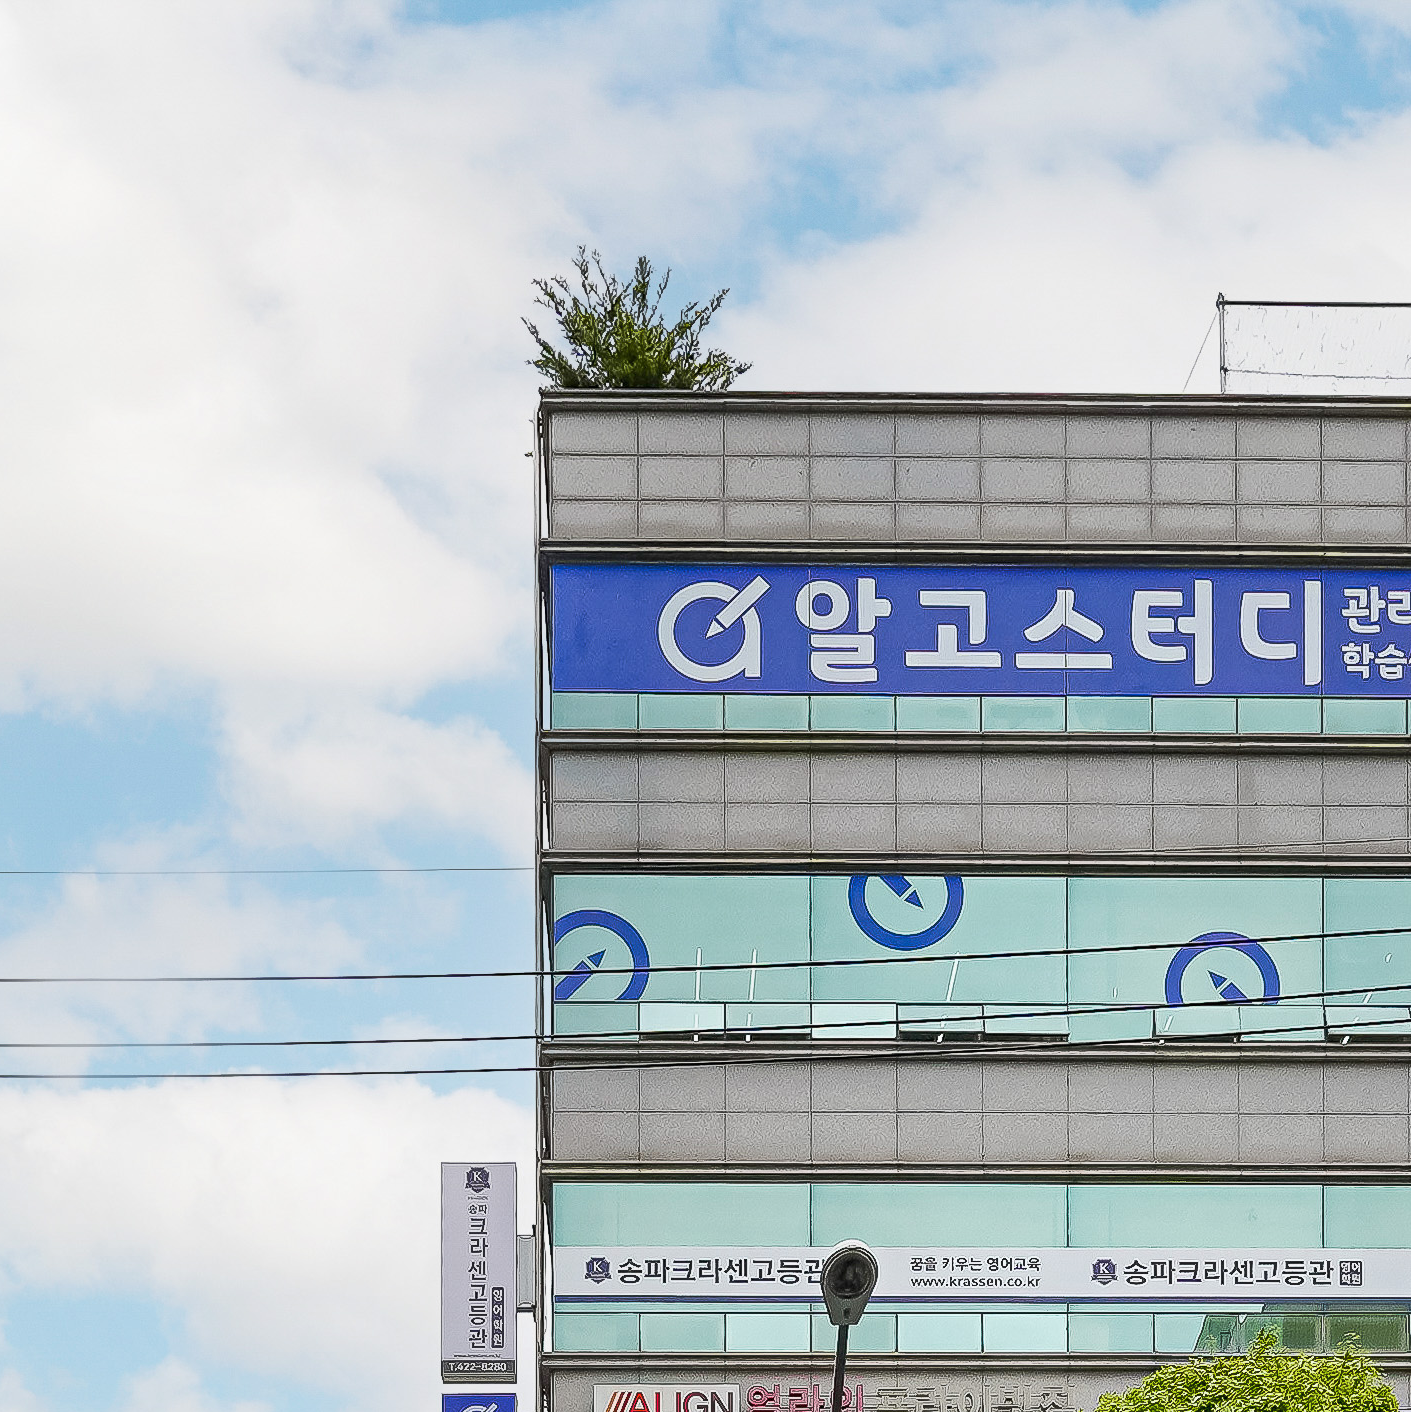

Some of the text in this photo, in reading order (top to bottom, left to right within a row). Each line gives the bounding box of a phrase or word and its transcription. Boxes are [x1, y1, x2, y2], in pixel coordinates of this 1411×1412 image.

[796, 578, 1324, 690] 알고스터디
[910, 1257, 1041, 1271] 꿈을 키우는 영어교육
[1124, 1260, 1334, 1285] 송파크라센고등관
[911, 1276, 1040, 1287] www.krassen.co.kr
